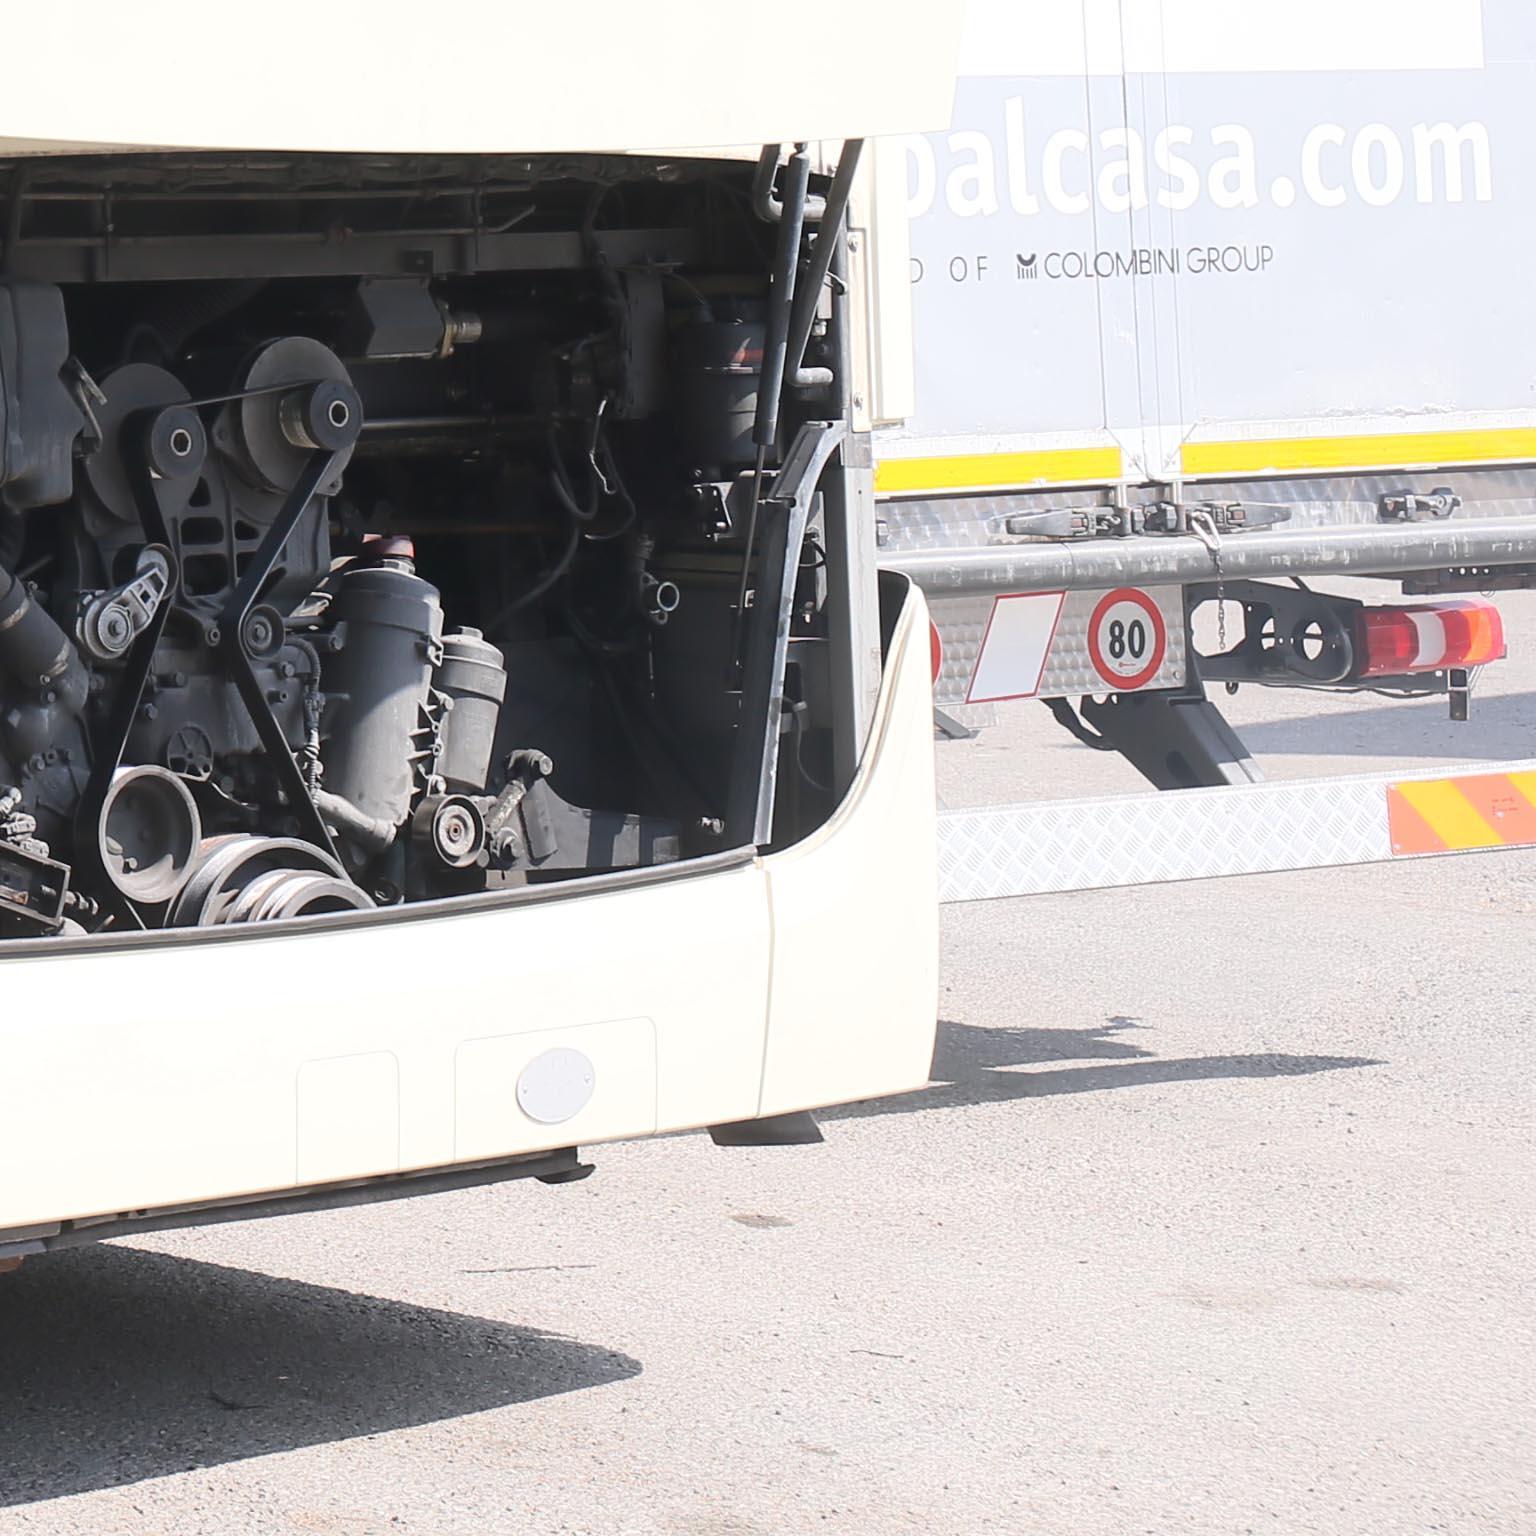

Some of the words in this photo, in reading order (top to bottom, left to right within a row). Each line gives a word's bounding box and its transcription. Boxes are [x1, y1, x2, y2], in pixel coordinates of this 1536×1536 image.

[1044, 249, 1180, 279] COLOMBINI
[1186, 245, 1274, 274] GROUP
[1109, 618, 1146, 660] 80
